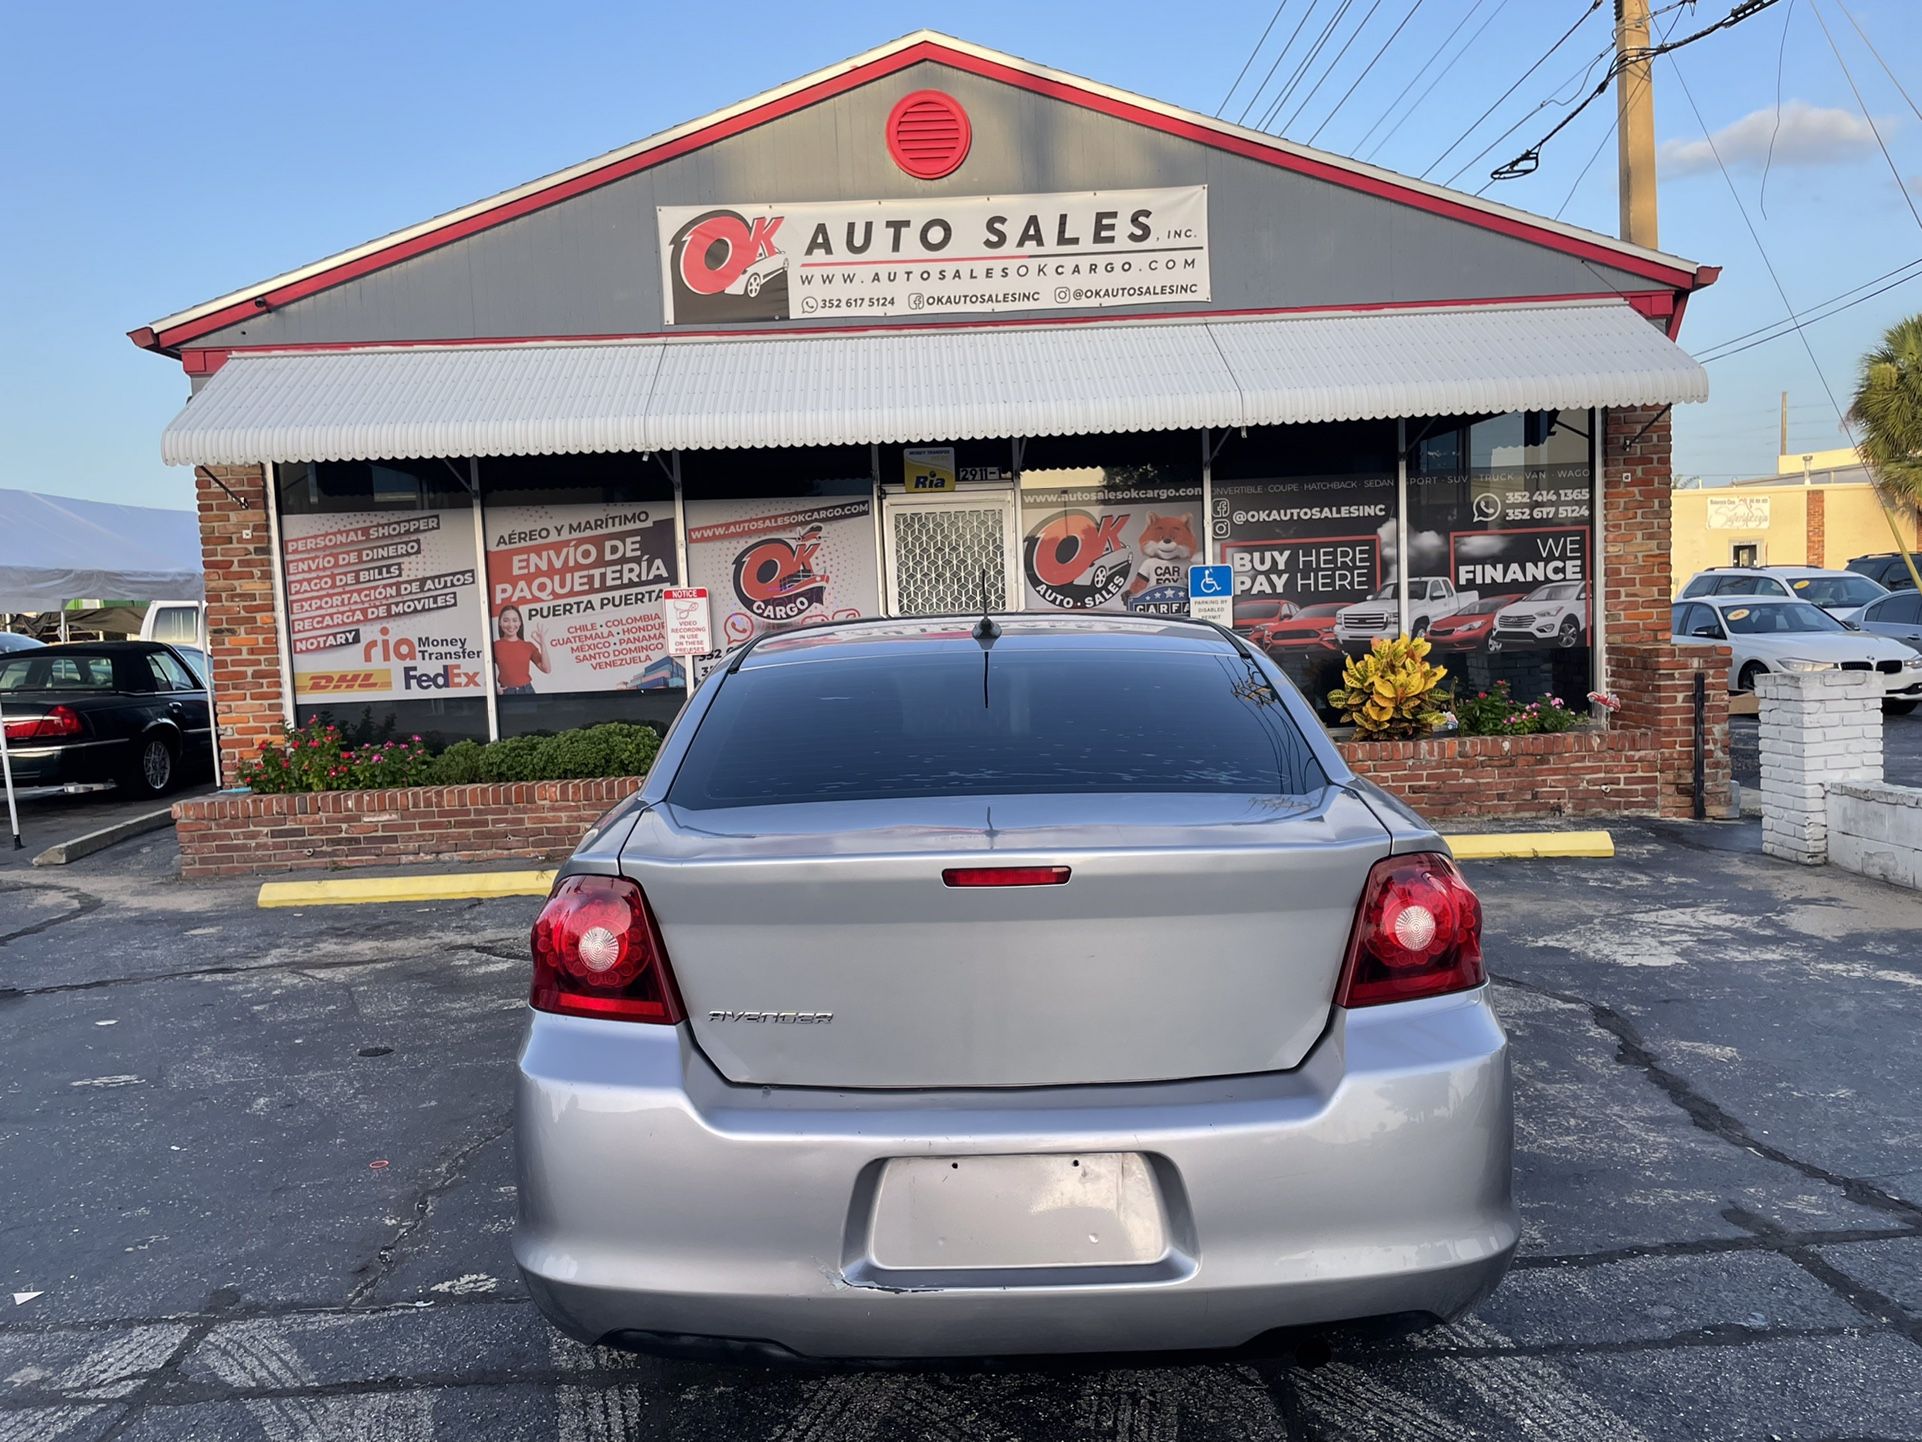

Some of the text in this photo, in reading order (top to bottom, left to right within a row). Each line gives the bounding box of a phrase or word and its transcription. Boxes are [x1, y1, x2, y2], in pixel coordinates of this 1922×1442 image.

[804, 218, 952, 256] AUTO
[1167, 228, 1197, 240] INC.
[676, 211, 785, 295] OK
[799, 258, 1196, 286] WWW.AUTOSALESOKCARGO.COM
[820, 296, 895, 309] 352 617 5124
[926, 291, 1040, 306] OKAUTOSALESINC
[1072, 283, 1198, 300] @OKAUTOSALESINC
[914, 470, 946, 489] Ria
[1212, 485, 1263, 496] ONVERTIBLE
[1268, 483, 1299, 493] COUPE
[1364, 479, 1394, 488] SEDAN
[1406, 468, 1591, 486] PORT SUV TRUCK VAN WAGO
[1505, 488, 1590, 504] 352 414 1365
[690, 503, 869, 540] WWW.AUTOSALESOKCARGO.COM
[1232, 504, 1385, 525] @OKAUTOSALESINC
[1505, 505, 1590, 521] 352 617 5124
[287, 517, 438, 553] PERSONAL SHOPPER
[495, 510, 650, 547] AÉREO Y MARÍTIMO
[289, 541, 418, 574] ENVÍO DE DINERO
[512, 535, 641, 576] ENVÍO DE
[1034, 514, 1131, 587] OK
[1536, 536, 1581, 558] WE
[1232, 546, 1371, 573] BUY HERE
[290, 565, 400, 594] PAGO DE BILLS
[495, 554, 669, 605] PAQUETERÍA
[741, 542, 821, 601] OK
[1154, 565, 1180, 577] CAR
[1458, 560, 1582, 586] FINANCE
[292, 572, 474, 614] EXPORTACIÓN DE AUTOS
[672, 589, 698, 598] NOTICE
[1035, 574, 1125, 609] AUTO SALES
[1234, 569, 1369, 596] PAY HERE
[294, 594, 455, 632] RECARGA DE MOVILES
[528, 588, 664, 621] PUERTA PUERTA
[752, 596, 809, 619] CARGO
[1136, 602, 1190, 614] CARFA
[567, 612, 661, 634] CHILE COLOMBIA
[295, 631, 356, 652] NOTARY
[363, 626, 416, 663] ria
[418, 636, 467, 649] Money
[550, 630, 615, 647] GUATEMALA
[570, 632, 666, 654] MEXICO PANAMÁ
[418, 648, 482, 661] Transfer
[575, 642, 664, 664] SANTO DOMINGO
[590, 654, 652, 671] VENEZUELA
[309, 673, 379, 691] DHL
[403, 664, 481, 690] FedEx
[708, 1010, 834, 1025] AVENGER
